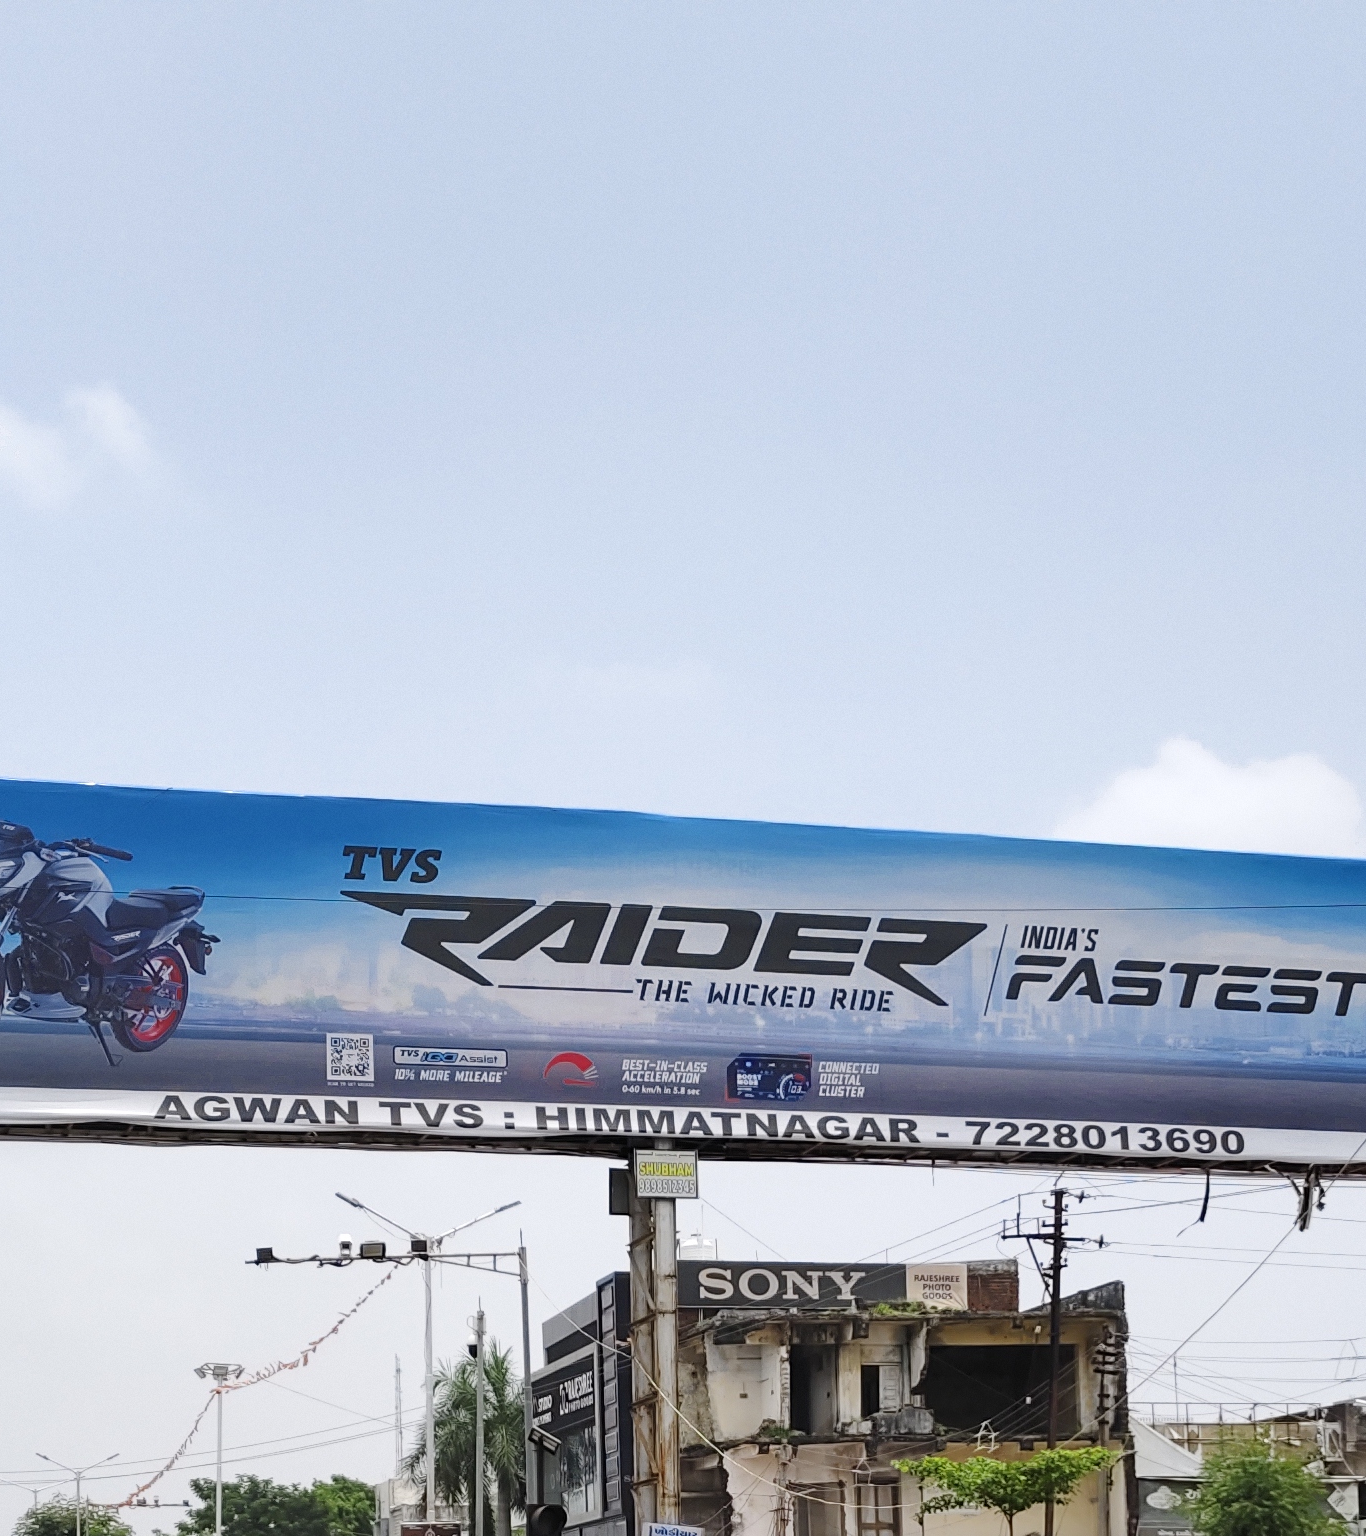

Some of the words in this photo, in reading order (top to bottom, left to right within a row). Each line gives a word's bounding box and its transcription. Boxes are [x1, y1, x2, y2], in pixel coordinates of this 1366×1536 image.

[342, 845, 442, 884] TVS
[1020, 924, 1099, 952] INDIA'S
[340, 890, 989, 1007] RAIDER
[636, 978, 689, 1004] THE
[707, 982, 816, 1009] WICKED
[829, 986, 894, 1012] RIDE
[400, 1049, 420, 1058] TVS
[621, 1059, 708, 1073] BEST-IN-CLASS
[818, 1061, 879, 1075] CONNECTED
[394, 1068, 415, 1081] 10%
[420, 1069, 450, 1082] MORE
[621, 1071, 700, 1084] ACCELERATION
[819, 1073, 861, 1086] DIGITAL
[818, 1085, 865, 1098] CLUSTER
[154, 1094, 359, 1127] AGWAN
[378, 1101, 484, 1130] TVS
[536, 1105, 922, 1144] HIMMATNAGAR
[964, 1120, 1247, 1155] 7228013690
[638, 1161, 695, 1178] SHUBHAM
[698, 1267, 866, 1301] SONY
[913, 1274, 960, 1284] RAJESHREE
[922, 1283, 951, 1292] PHOTO
